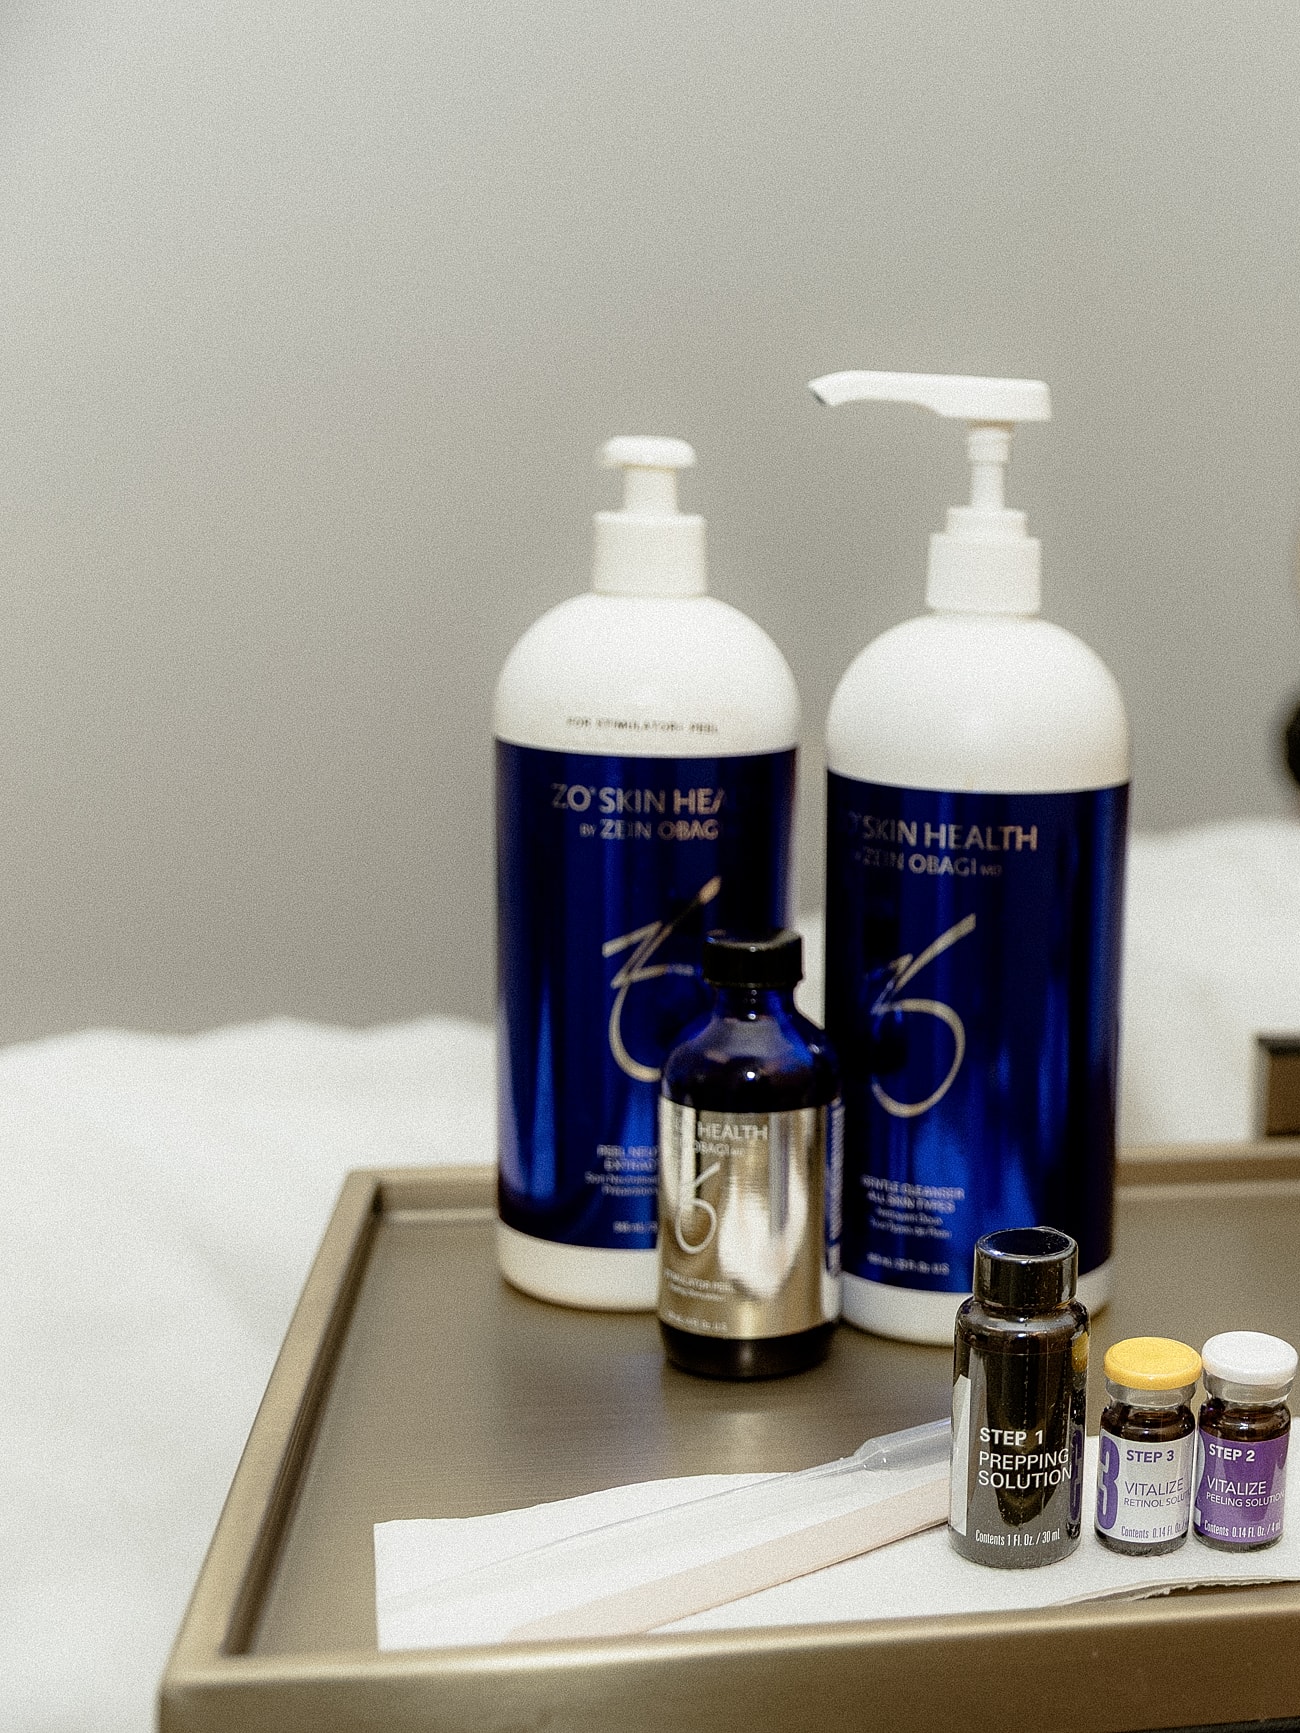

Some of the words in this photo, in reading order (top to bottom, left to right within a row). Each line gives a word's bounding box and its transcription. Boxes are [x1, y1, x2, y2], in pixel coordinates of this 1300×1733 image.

[599, 787, 666, 814] SKIN
[600, 819, 652, 840] ZEIN
[862, 815, 917, 847] SKIN
[924, 822, 1038, 851] HEALTH
[908, 853, 977, 877] OBAGI
[697, 1121, 767, 1141] HEALTH
[979, 1427, 1027, 1447] STEP
[1035, 1429, 1044, 1445] 1
[979, 1448, 1069, 1471] PREPPING
[1126, 1449, 1163, 1463] STEP
[1166, 1449, 1175, 1462] 3
[1209, 1443, 1242, 1462] STEP
[1245, 1449, 1255, 1462] 2
[978, 1464, 1072, 1489] SOLUTION
[1207, 1475, 1267, 1495] VITALIZE
[1124, 1477, 1184, 1497] VITALIZE
[1123, 1496, 1164, 1508] RETINOL
[1206, 1491, 1243, 1507] PEELING
[1245, 1490, 1285, 1507] SOLUTION
[975, 1529, 1005, 1546] Contents
[1007, 1534, 1011, 1546] 1
[1024, 1533, 1034, 1546] Oz.
[1035, 1532, 1041, 1545] /
[1042, 1529, 1051, 1543] 30
[1121, 1525, 1149, 1539] Contents
[1152, 1526, 1166, 1539] 0.14
[1204, 1520, 1229, 1537] Contents
[1231, 1527, 1246, 1539] 0.14
[1257, 1525, 1266, 1537] Oz.
